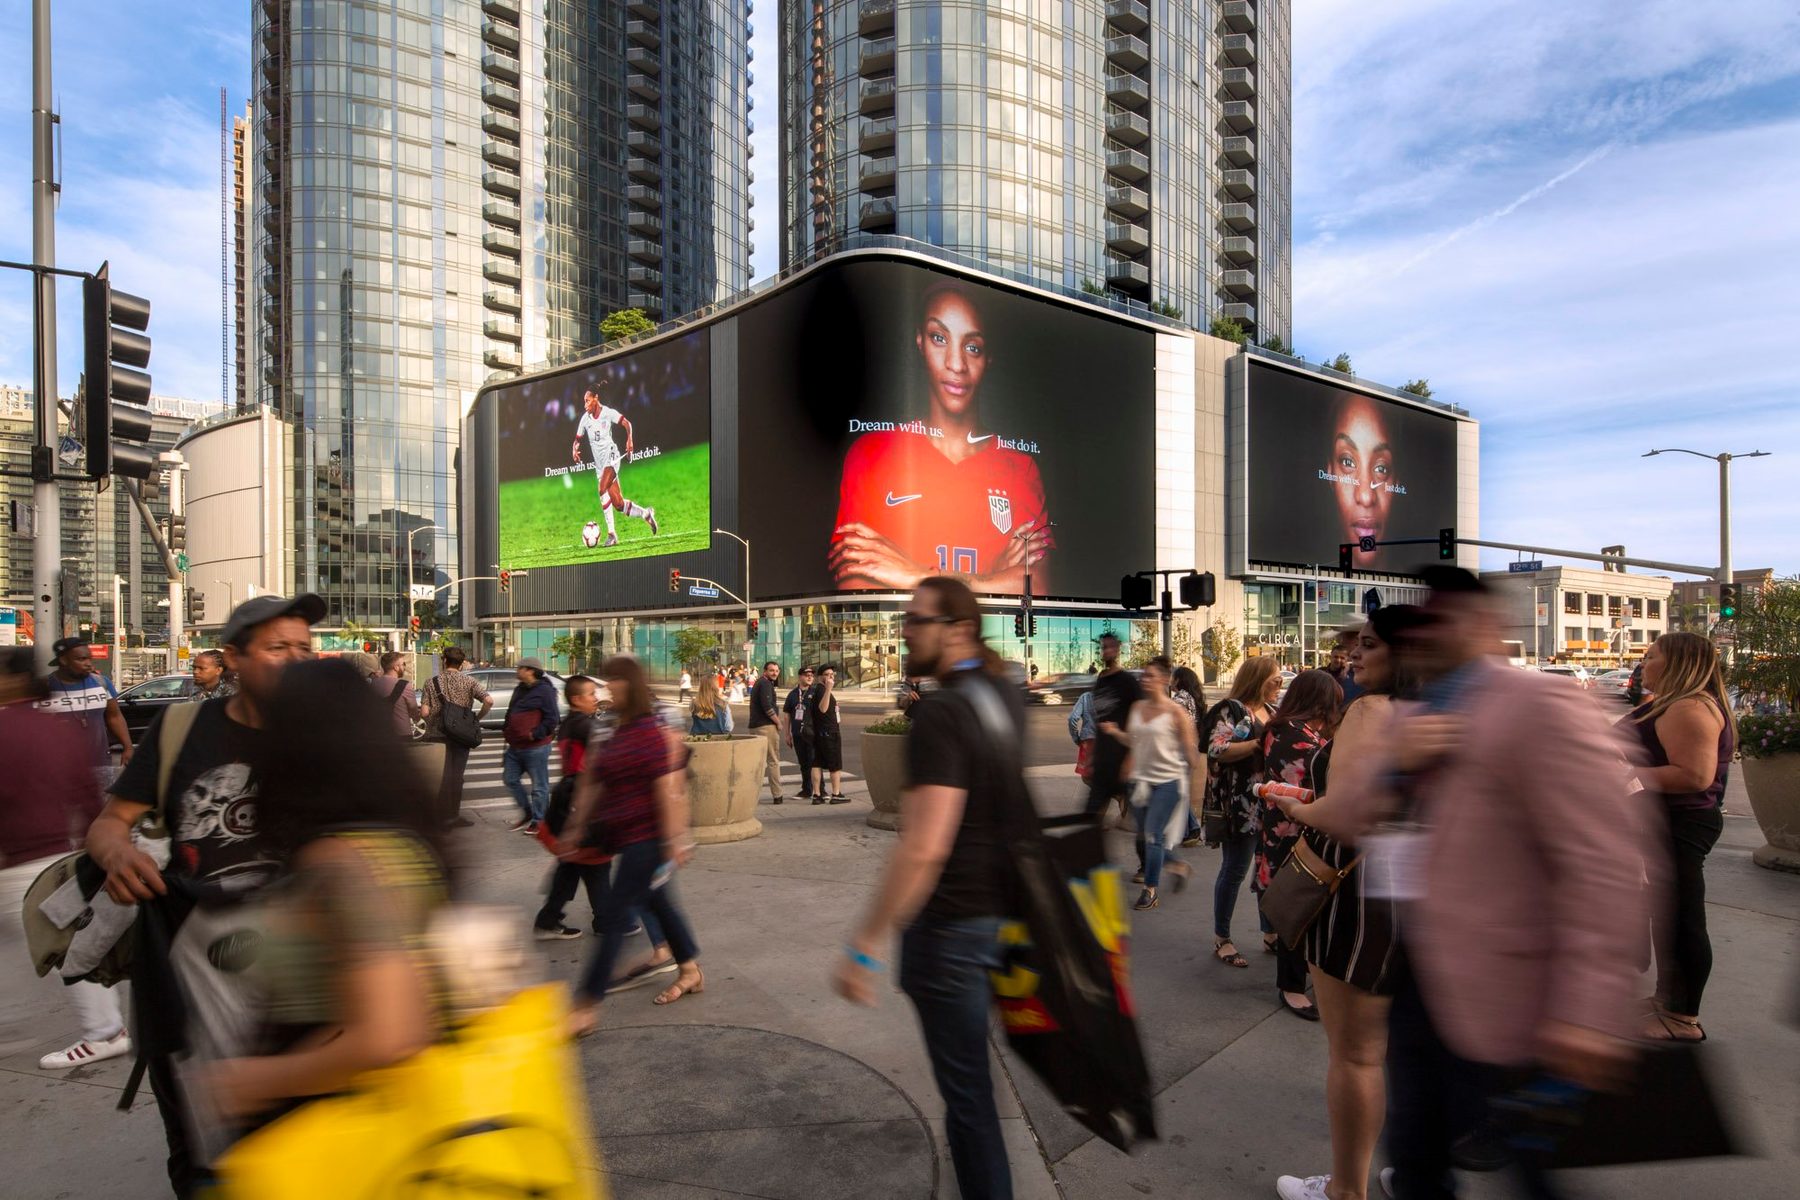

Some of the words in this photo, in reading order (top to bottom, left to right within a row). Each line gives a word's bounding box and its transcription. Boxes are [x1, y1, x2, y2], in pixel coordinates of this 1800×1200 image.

[849, 419, 895, 433] Dream
[898, 420, 926, 435] with
[929, 427, 944, 438] us.
[996, 434, 1016, 450] Just
[1016, 439, 1030, 452] do
[1030, 441, 1041, 454] it.
[629, 450, 643, 464] Just
[643, 447, 653, 458] do
[653, 446, 661, 456] it.
[545, 467, 568, 477] Dream
[570, 461, 586, 472] with
[1318, 470, 1338, 481] Dream
[990, 497, 1010, 513] USA
[935, 544, 978, 574] 10
[1258, 632, 1301, 645] CIRCA
